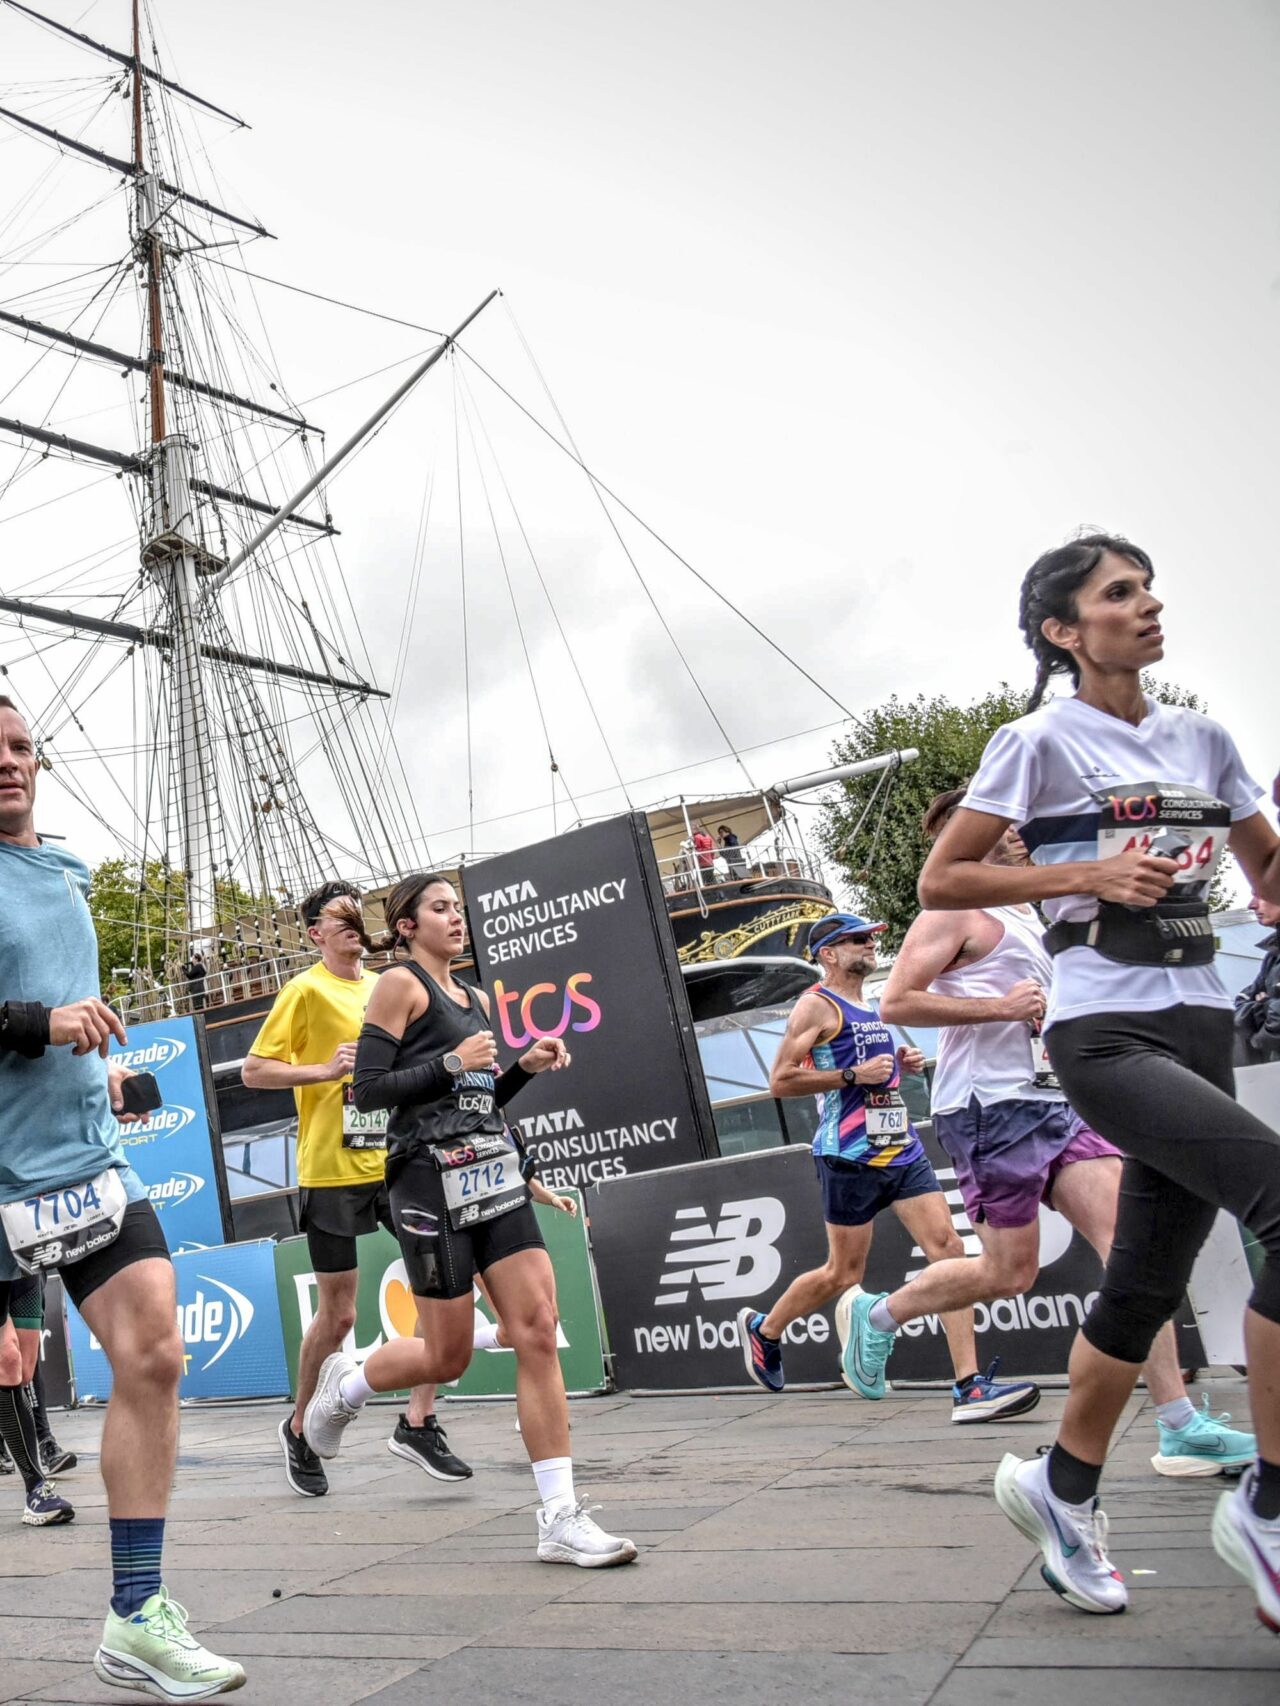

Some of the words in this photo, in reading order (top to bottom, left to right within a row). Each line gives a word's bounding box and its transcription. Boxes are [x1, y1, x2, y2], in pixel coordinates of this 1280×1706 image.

[1158, 810, 1204, 820] SERVICES
[477, 880, 538, 913] TATA
[483, 878, 627, 939] CONSULTANCY
[754, 916, 781, 933] CUTTY
[782, 910, 800, 921] SARK
[487, 922, 578, 965] SERVICES
[494, 972, 601, 1049] tcs
[851, 1020, 886, 1034] Pancre
[854, 1032, 890, 1047] Cancer
[107, 1043, 170, 1067] ozade
[120, 1109, 179, 1136] ozade
[519, 1109, 585, 1139] TATA
[119, 1133, 159, 1147] PORT
[476, 1148, 500, 1159] SERVICES
[527, 1117, 678, 1166] CONSULTANCY
[442, 1145, 474, 1166] tcs
[458, 1161, 505, 1197] 2712
[535, 1157, 627, 1190] ERVICES
[24, 1182, 101, 1231] 7704
[481, 1205, 495, 1217] new
[495, 1195, 526, 1212] balance
[65, 1244, 86, 1259] new
[86, 1228, 120, 1249] balanc
[973, 1291, 1101, 1334] balanc
[634, 1324, 690, 1354] new
[696, 1312, 830, 1350] bace
